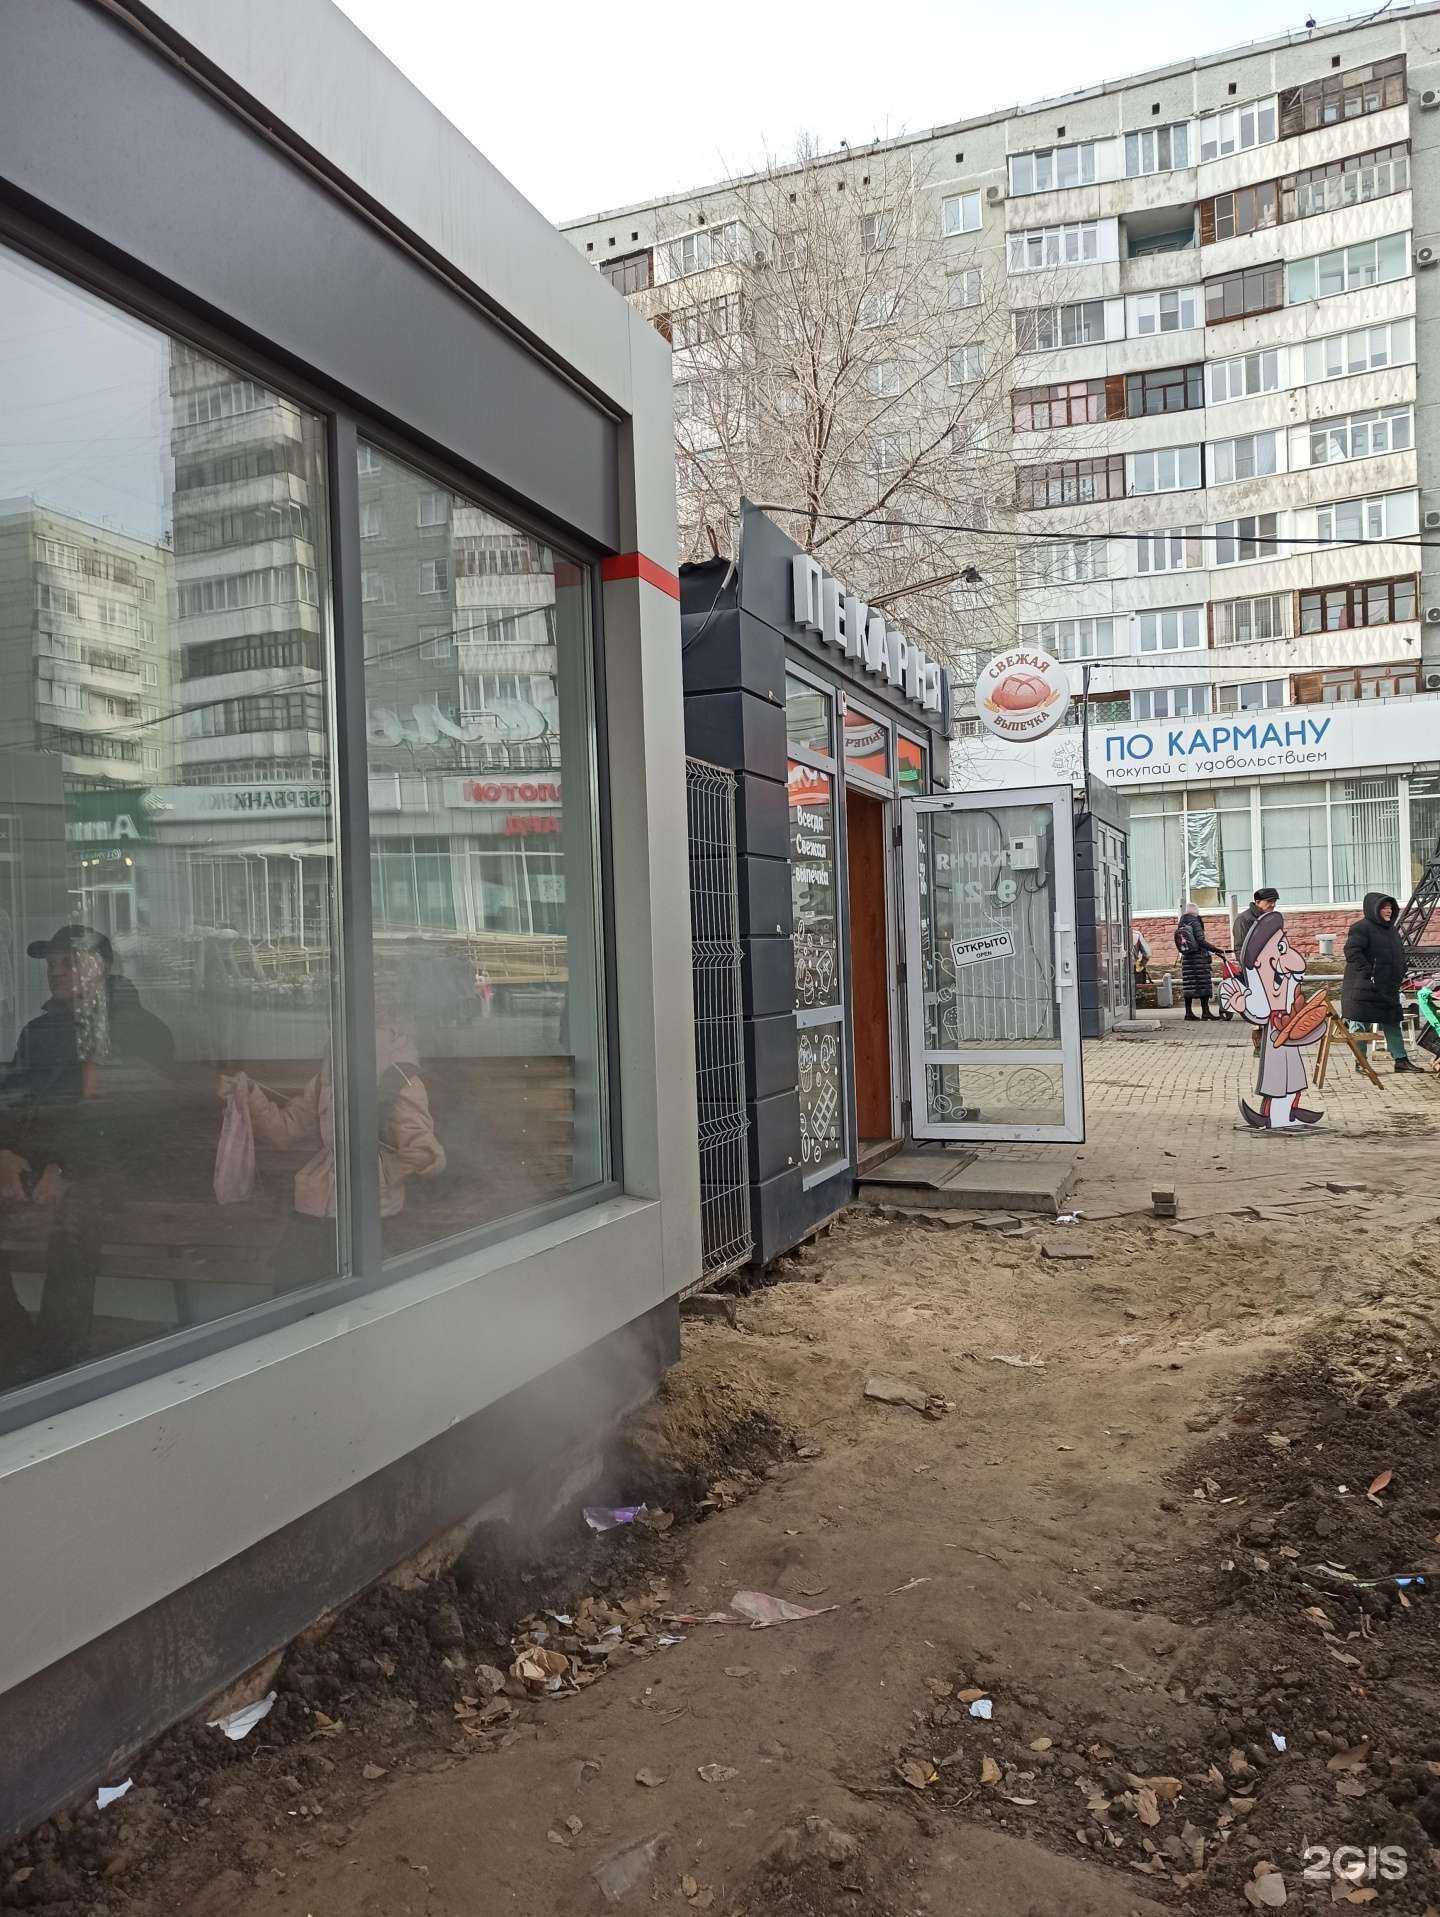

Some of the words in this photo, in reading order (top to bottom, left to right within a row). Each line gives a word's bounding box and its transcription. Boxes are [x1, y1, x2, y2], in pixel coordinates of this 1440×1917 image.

[793, 554, 942, 712] ПЕКАРНЯ
[989, 654, 1050, 679] СВЕЖАЯ
[993, 710, 1051, 731] ВЫПЕЧКА
[1106, 734, 1153, 761] ПО
[1168, 717, 1331, 757] КАРМАНУ
[1106, 762, 1171, 778] покупай
[1178, 763, 1187, 773] с
[1196, 750, 1327, 772] удовольствием
[797, 805, 824, 832] Всегда
[796, 833, 827, 858] Свежая
[795, 866, 829, 886] выпечка
[956, 936, 1007, 955] ОТКРЫТО
